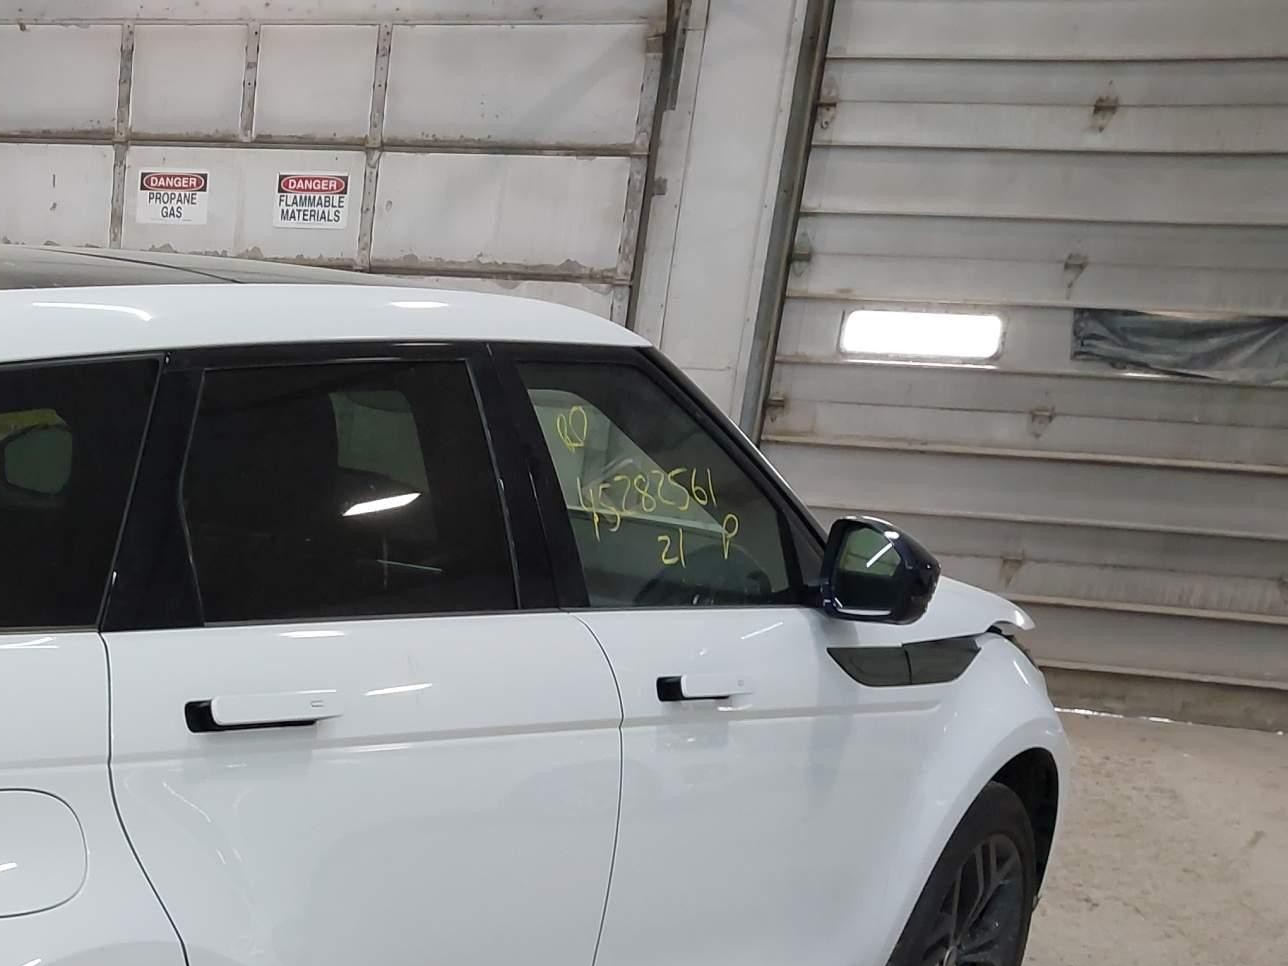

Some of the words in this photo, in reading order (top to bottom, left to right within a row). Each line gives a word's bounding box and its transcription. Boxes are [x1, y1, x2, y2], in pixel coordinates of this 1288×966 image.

[150, 176, 197, 187] DANGER
[288, 179, 337, 190] DANGER
[148, 192, 197, 205] PROPANE
[278, 194, 345, 208] FLAMMABLE
[161, 205, 183, 219] GAS
[280, 208, 341, 223] MATERIALS
[657, 527, 687, 569] 21
